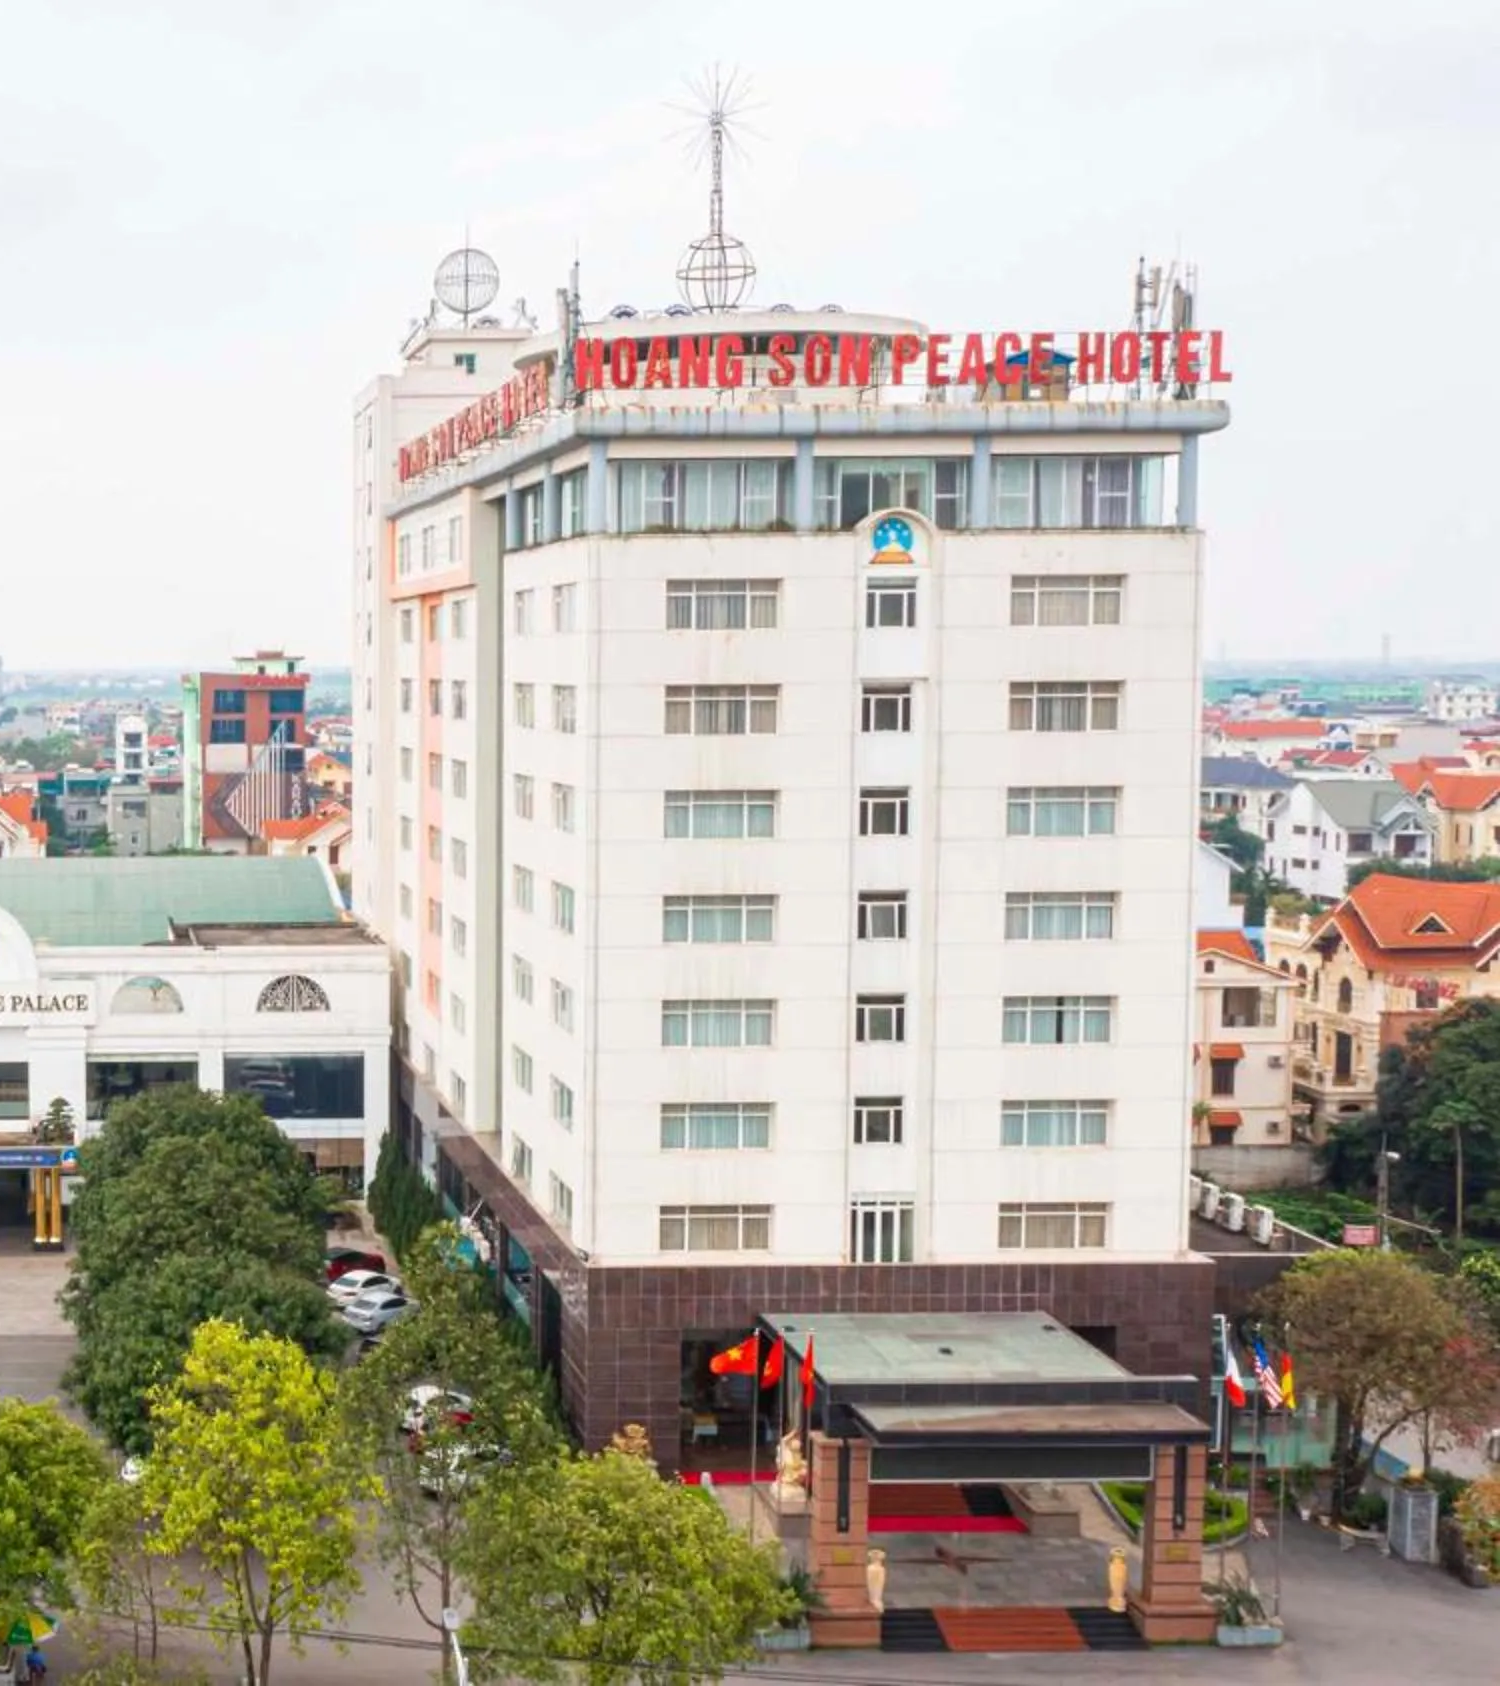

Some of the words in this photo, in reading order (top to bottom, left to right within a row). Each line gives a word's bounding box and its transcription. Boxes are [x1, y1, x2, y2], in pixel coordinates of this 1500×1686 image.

[574, 333, 744, 392] HOANG
[768, 333, 871, 388] SON
[891, 332, 1056, 386] PEACE
[1075, 331, 1233, 384] HOTEL
[11, 994, 89, 1012] PALACE
